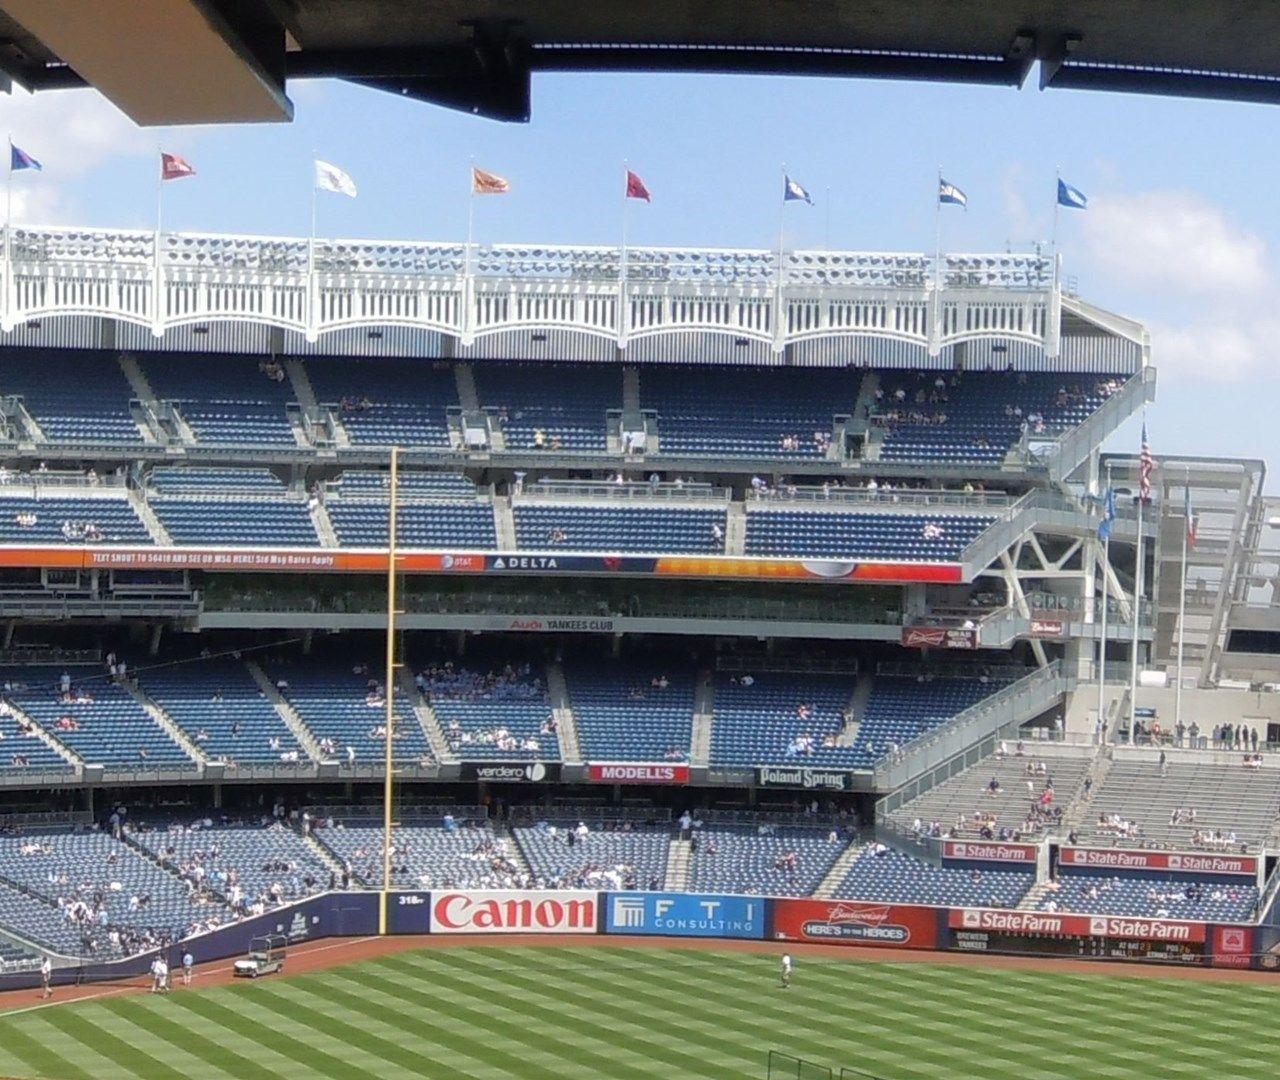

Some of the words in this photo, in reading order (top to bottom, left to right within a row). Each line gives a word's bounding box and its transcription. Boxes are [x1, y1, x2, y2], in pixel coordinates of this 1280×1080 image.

[547, 621, 587, 630] YANKEES
[589, 621, 613, 630] CLUB
[601, 766, 674, 779] MODELL'S
[760, 768, 802, 785] Poland
[802, 769, 845, 789] Spring
[435, 893, 595, 930] Canon
[654, 918, 753, 931] CONSULTING
[806, 924, 842, 936] HERE'S
[863, 927, 904, 939] HEROES
